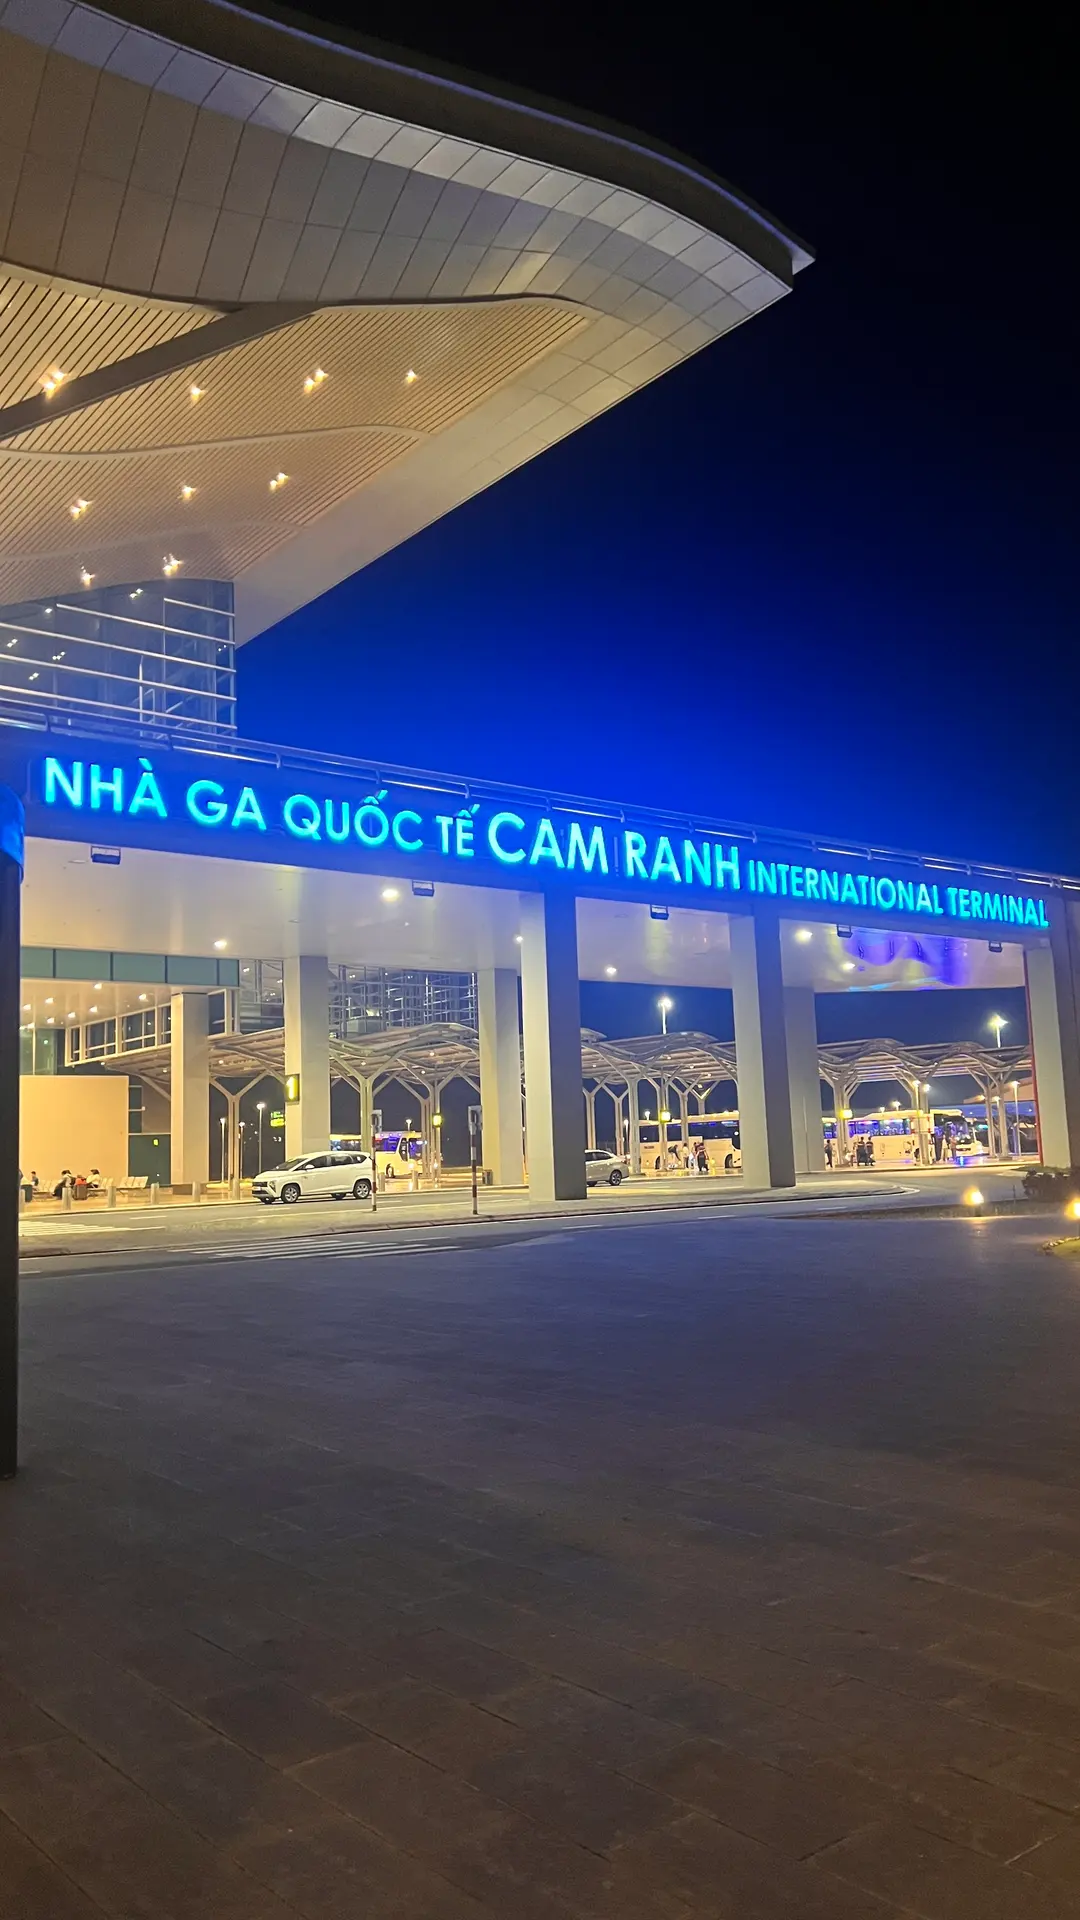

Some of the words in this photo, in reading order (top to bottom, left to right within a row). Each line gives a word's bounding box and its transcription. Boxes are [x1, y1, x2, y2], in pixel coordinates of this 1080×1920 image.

[43, 757, 168, 818] NHÀ
[186, 780, 267, 830] GA
[283, 789, 424, 851] QUỐC
[435, 803, 481, 857] TẾ
[487, 811, 609, 875] CAM
[623, 830, 741, 890] RANH
[747, 859, 943, 917] INTERNATIONAL
[947, 887, 1049, 928] TERMINAL
